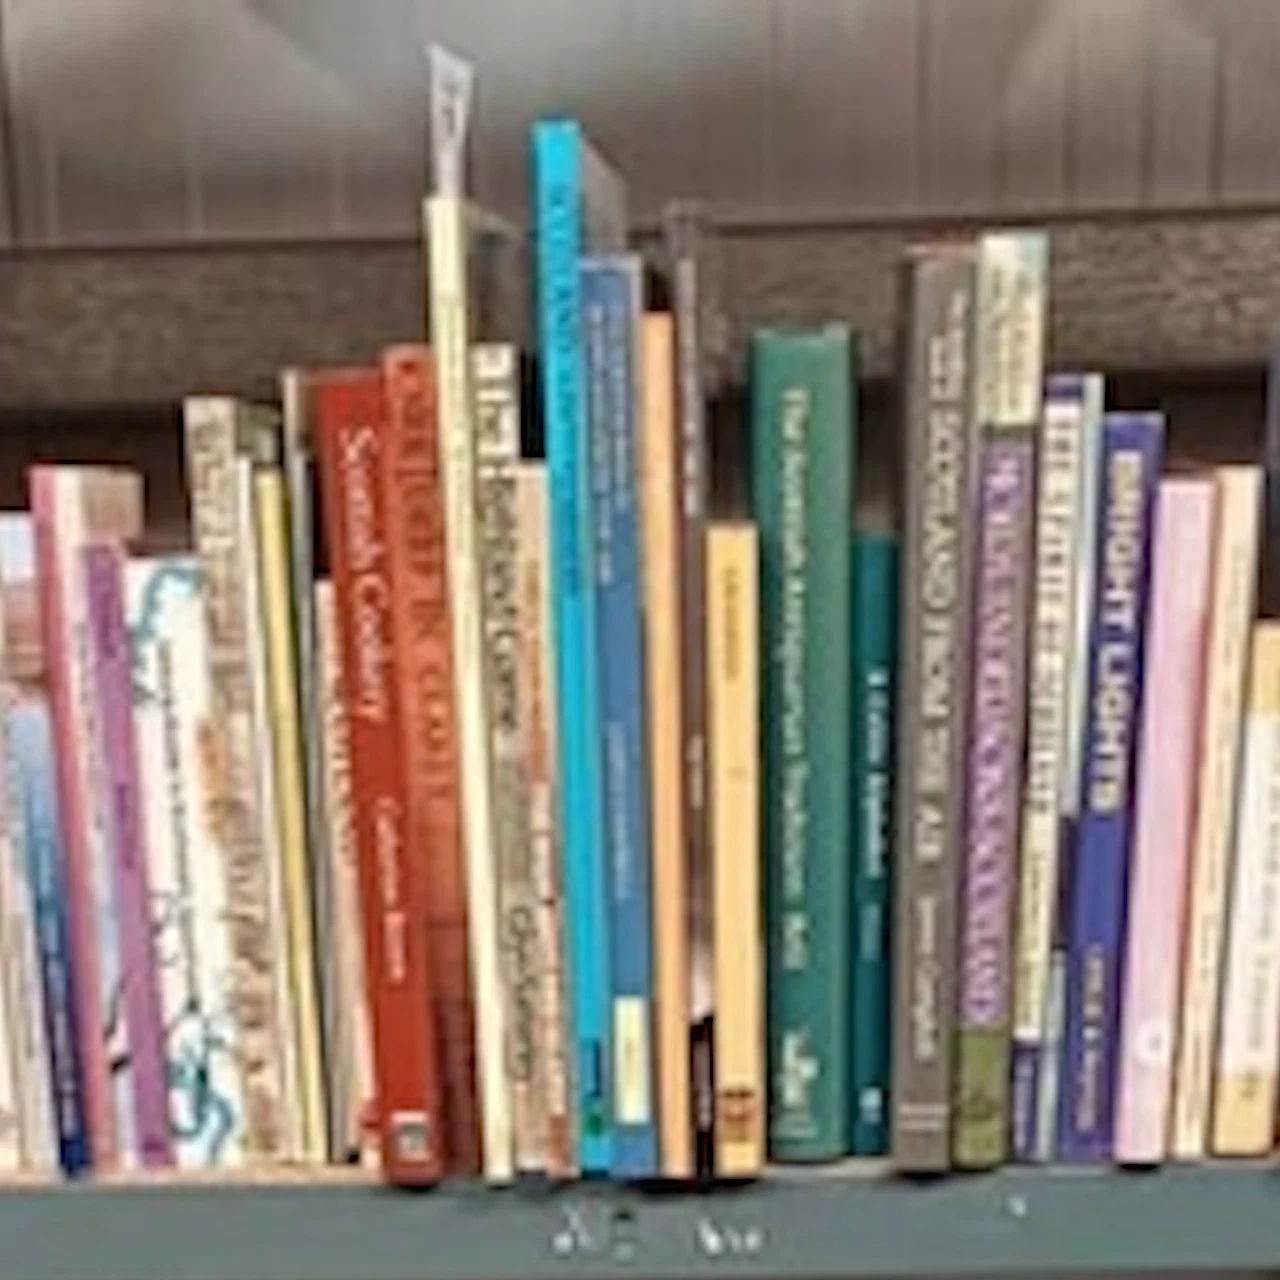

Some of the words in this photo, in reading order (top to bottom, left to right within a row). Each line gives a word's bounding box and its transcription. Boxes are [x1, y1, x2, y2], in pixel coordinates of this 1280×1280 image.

[922, 407, 964, 611] SCOTLAND
[1102, 452, 1146, 636] BRIGHT
[922, 613, 954, 718] FROM
[1087, 640, 1134, 815] LIGHTS
